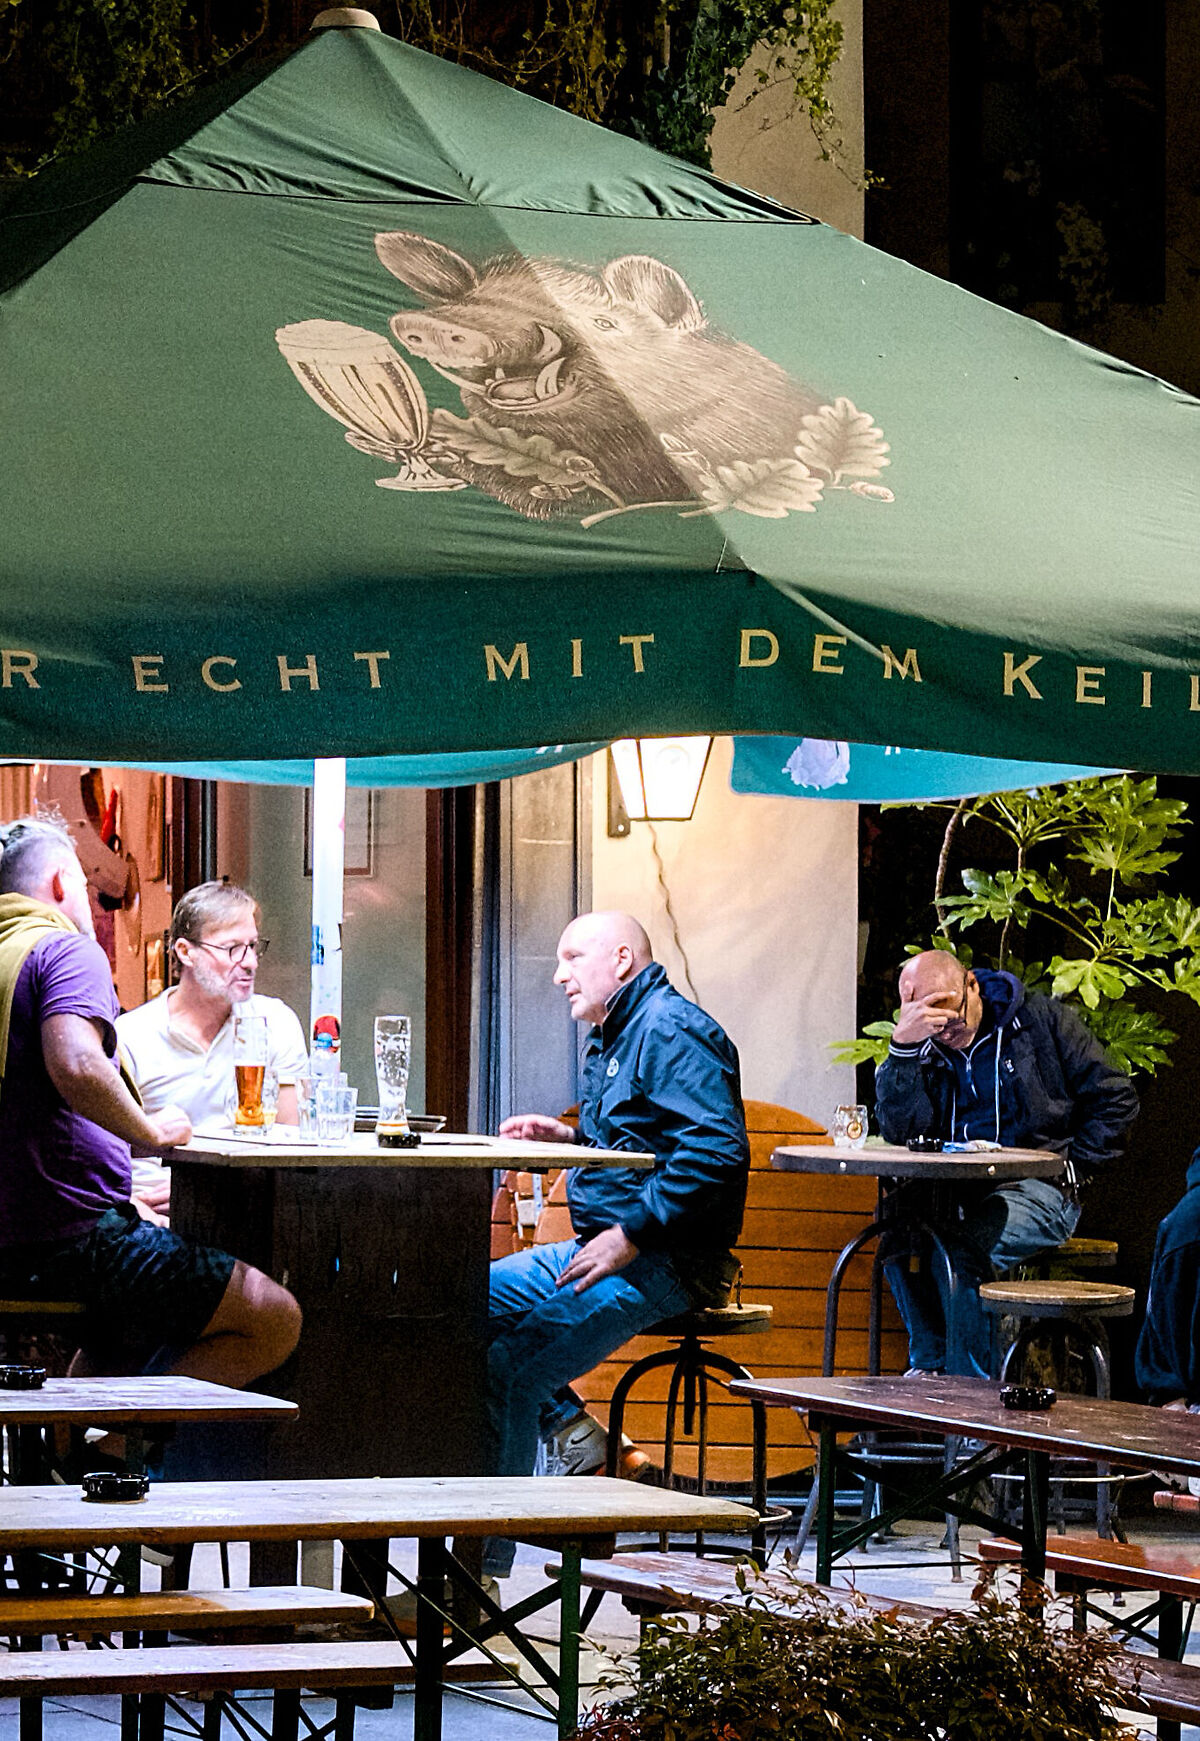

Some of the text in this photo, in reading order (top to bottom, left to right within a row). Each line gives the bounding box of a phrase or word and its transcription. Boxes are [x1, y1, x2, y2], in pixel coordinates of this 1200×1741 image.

[132, 651, 391, 692] ECHT
[485, 634, 656, 681] MIT
[739, 628, 923, 682] DEM
